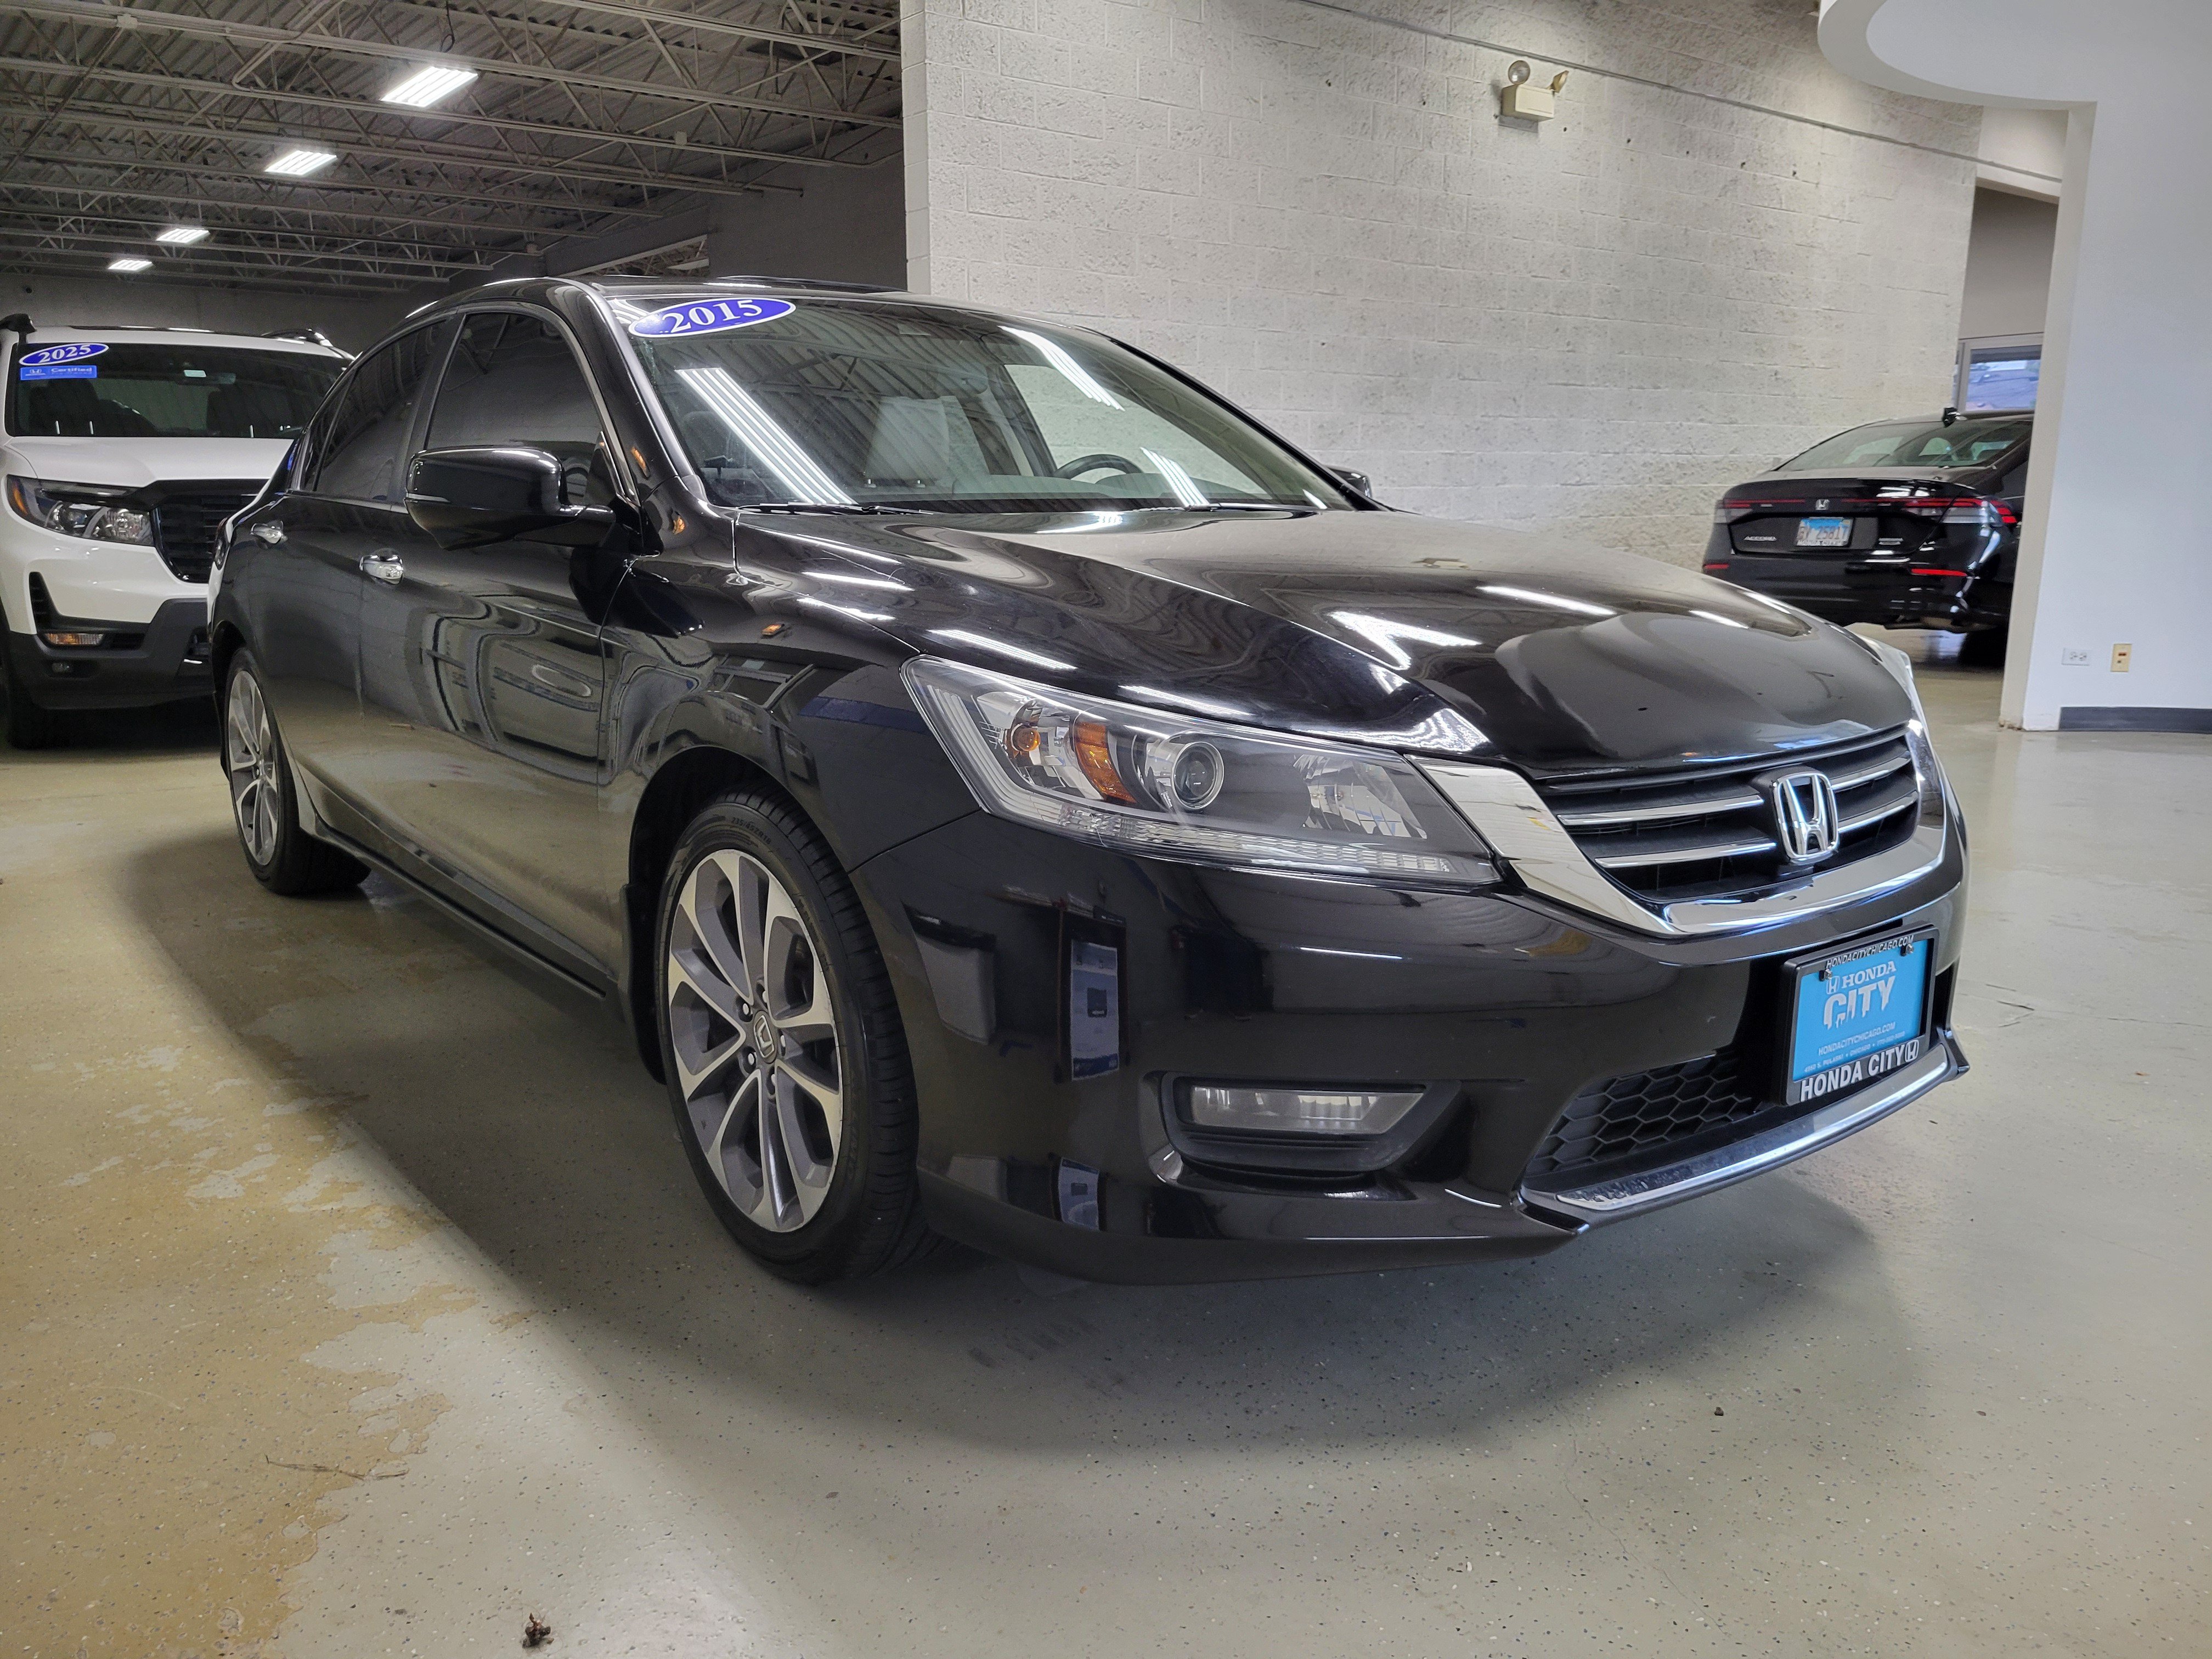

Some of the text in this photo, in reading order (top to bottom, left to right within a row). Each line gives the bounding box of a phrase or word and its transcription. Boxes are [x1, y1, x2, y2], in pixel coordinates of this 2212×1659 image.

[662, 300, 762, 333] 2015
[38, 344, 91, 364] 2025
[1826, 934, 1914, 969] HONDACITYCHICAGO.COM
[1841, 961, 1897, 989] HONDA
[1823, 975, 1896, 1030] CITY
[1818, 1022, 1896, 1056] HONDACITYCHICAGO.COM
[1800, 1044, 1905, 1102] HONDA CITY
